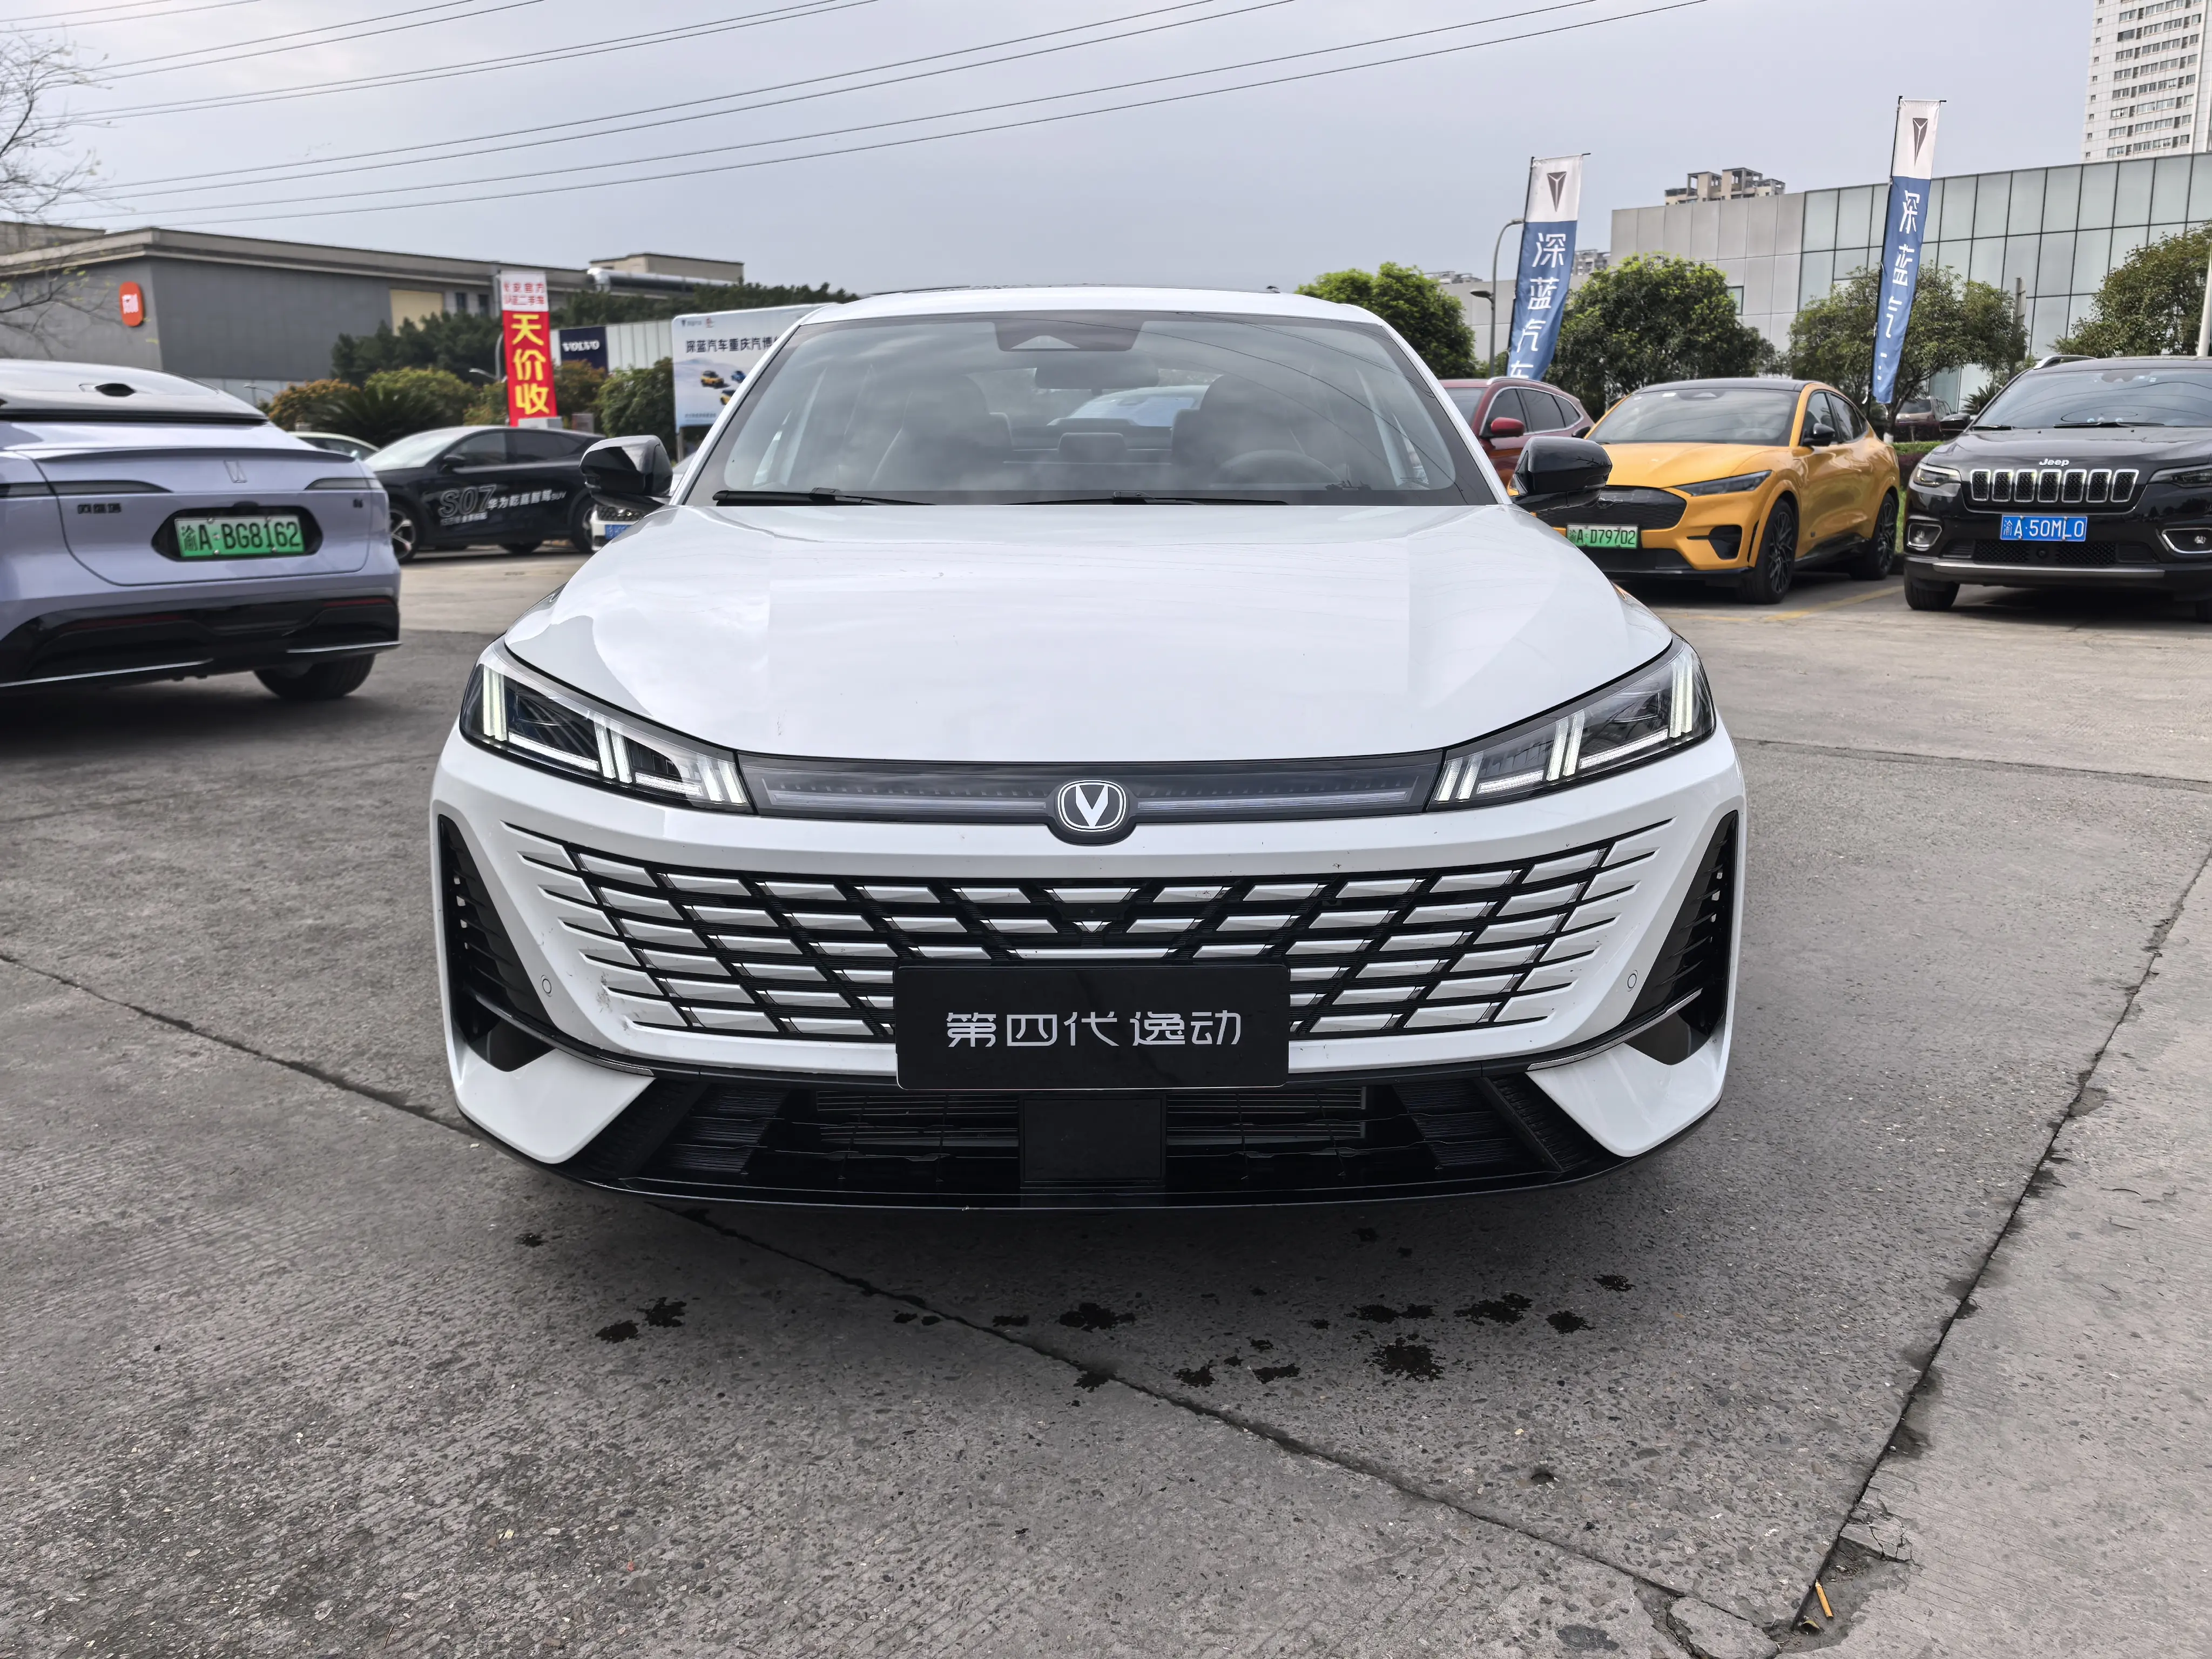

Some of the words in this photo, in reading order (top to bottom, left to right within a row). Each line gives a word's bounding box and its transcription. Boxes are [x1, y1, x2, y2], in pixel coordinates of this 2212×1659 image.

[562, 340, 600, 352] VOLVO
[511, 314, 550, 415] 天价收
[2039, 458, 2069, 467] Jeep
[438, 483, 496, 517] S07
[221, 522, 301, 549] BG8162
[1590, 530, 1635, 544] D79702
